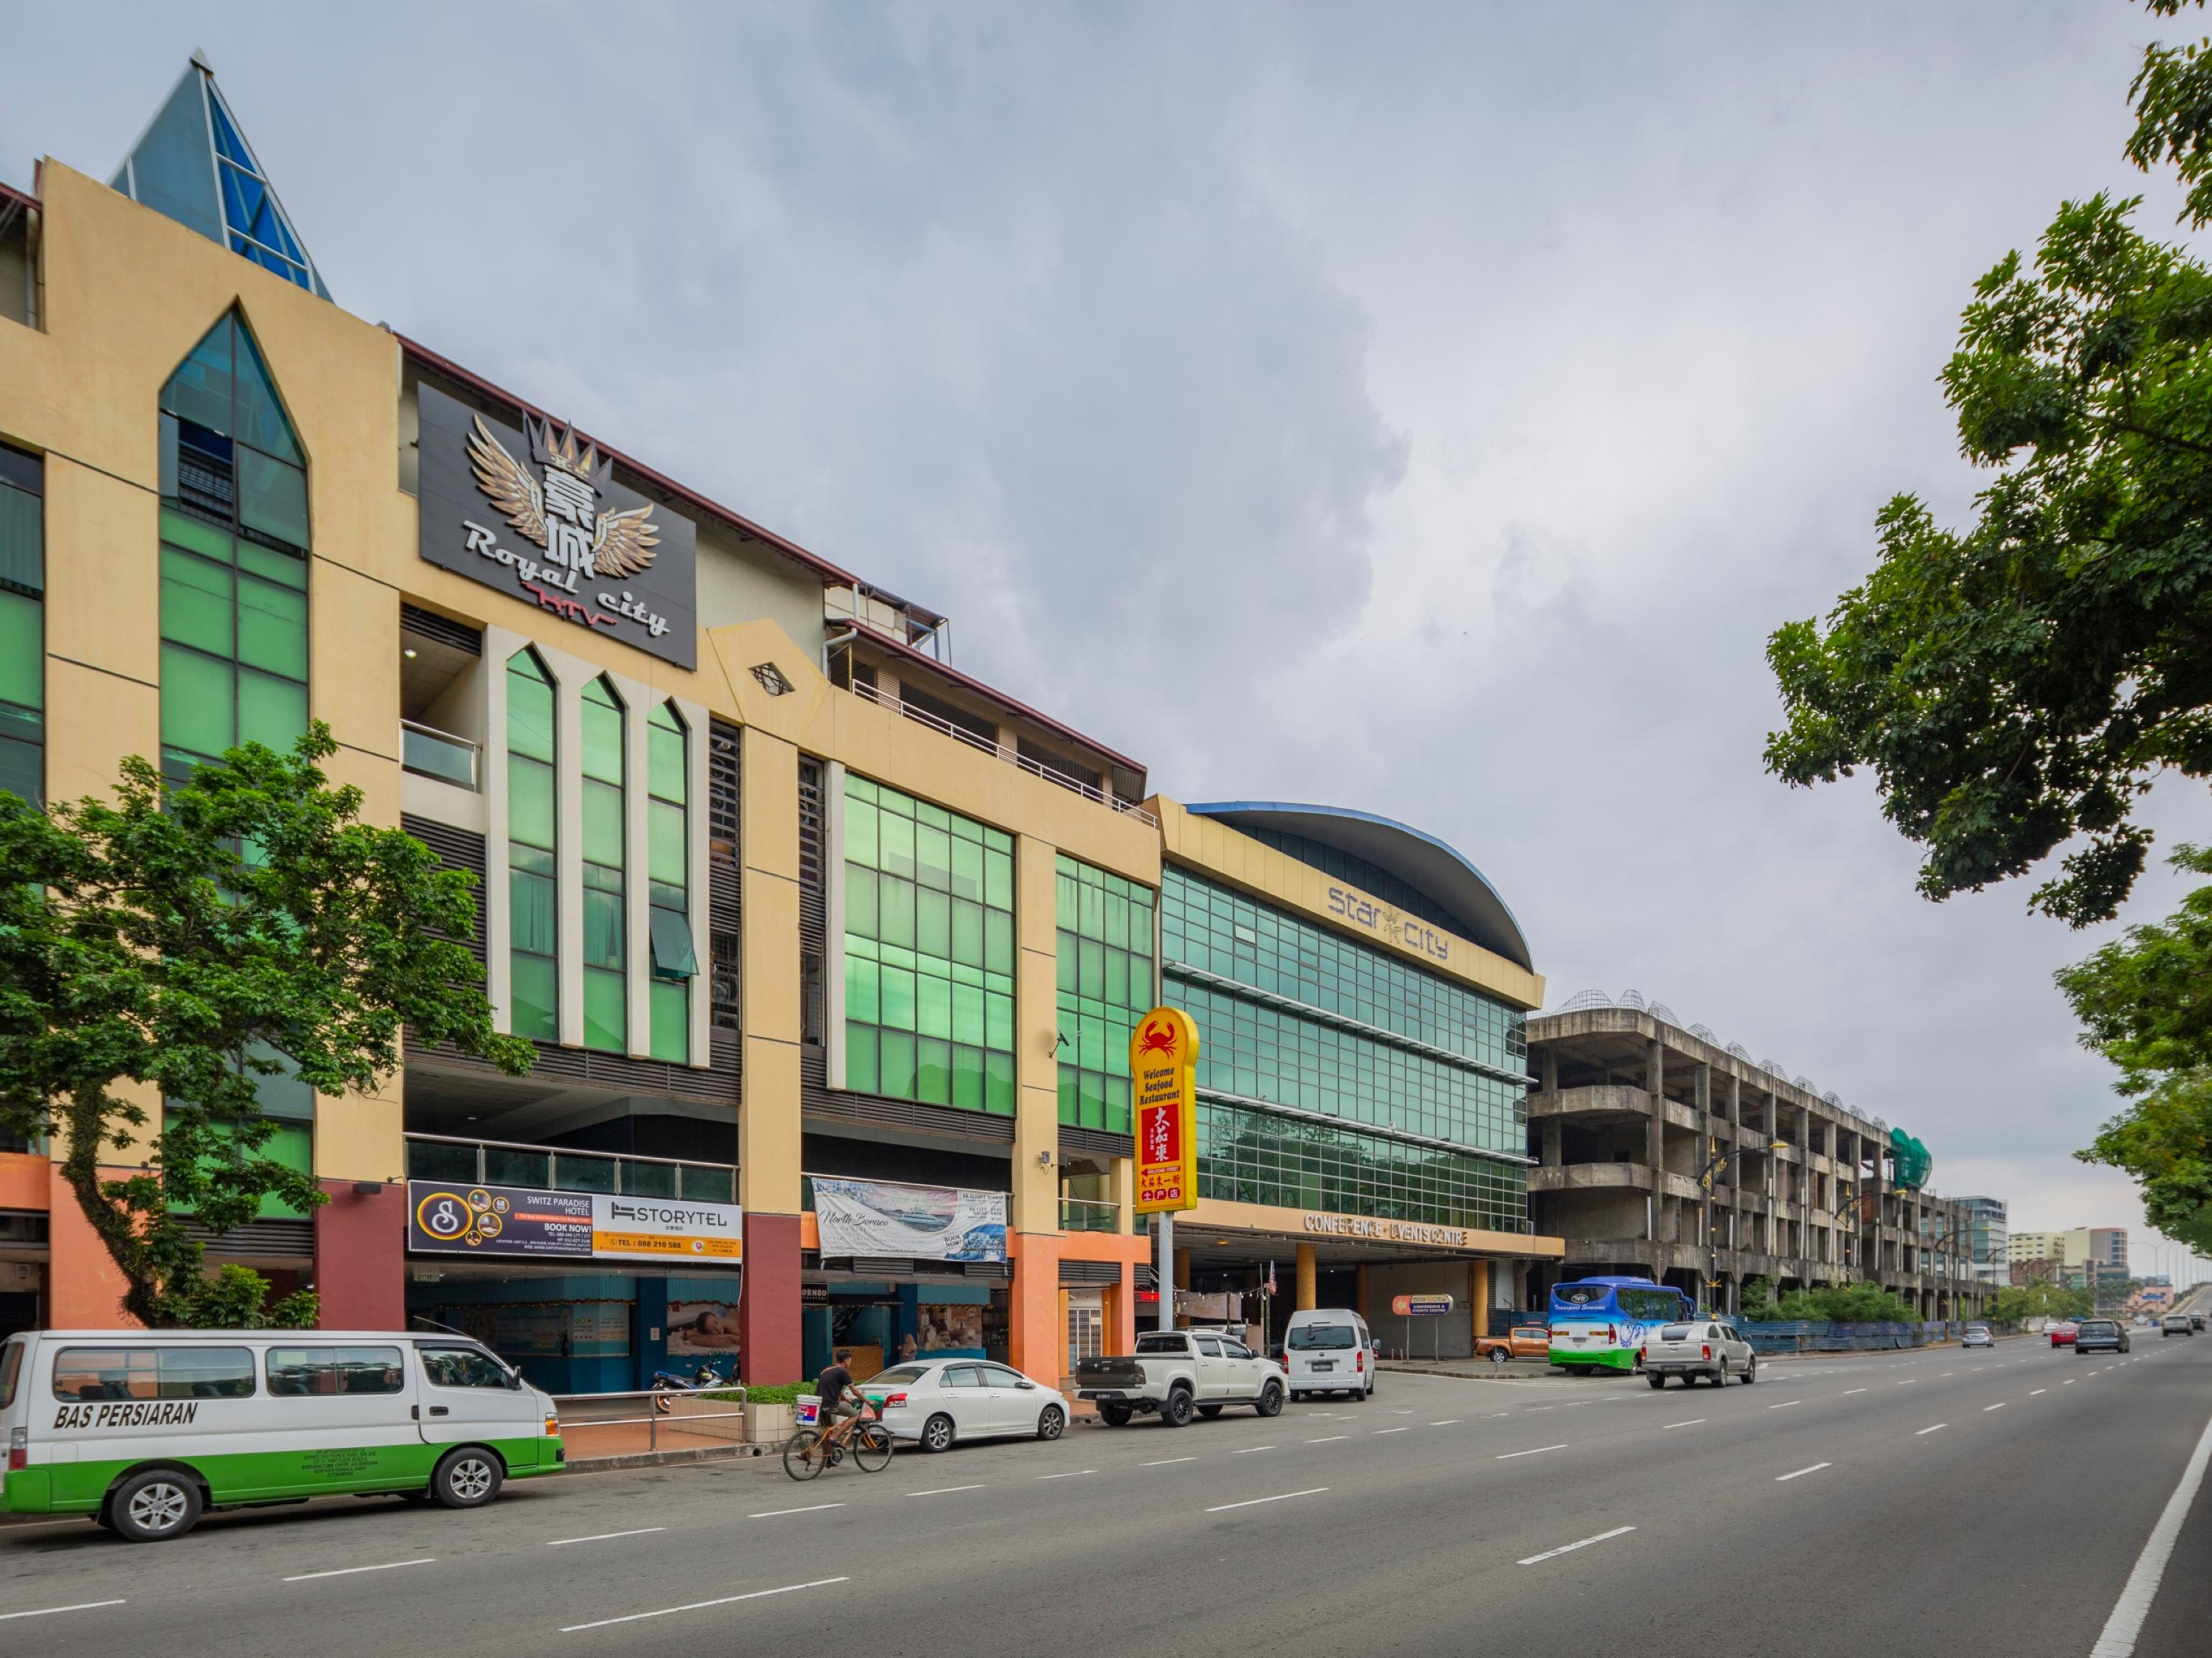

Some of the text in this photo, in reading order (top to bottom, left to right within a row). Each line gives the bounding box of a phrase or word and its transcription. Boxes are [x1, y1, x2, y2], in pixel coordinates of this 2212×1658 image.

[543, 464, 595, 579] 豪城
[463, 520, 671, 636] Royal city
[520, 581, 618, 625] KTV
[1143, 1067, 1174, 1080] Welcome
[1145, 1077, 1174, 1092] Seafood
[1140, 1089, 1180, 1105] Restaurant
[527, 1196, 589, 1208] SWITZ PARADISE
[637, 1207, 727, 1227] STORYTEL
[819, 1209, 889, 1227] North Borneo
[1305, 1213, 1467, 1246] CONFERENCE EVENTS CENTRE
[54, 1402, 198, 1429] BAS PERSIARAN
